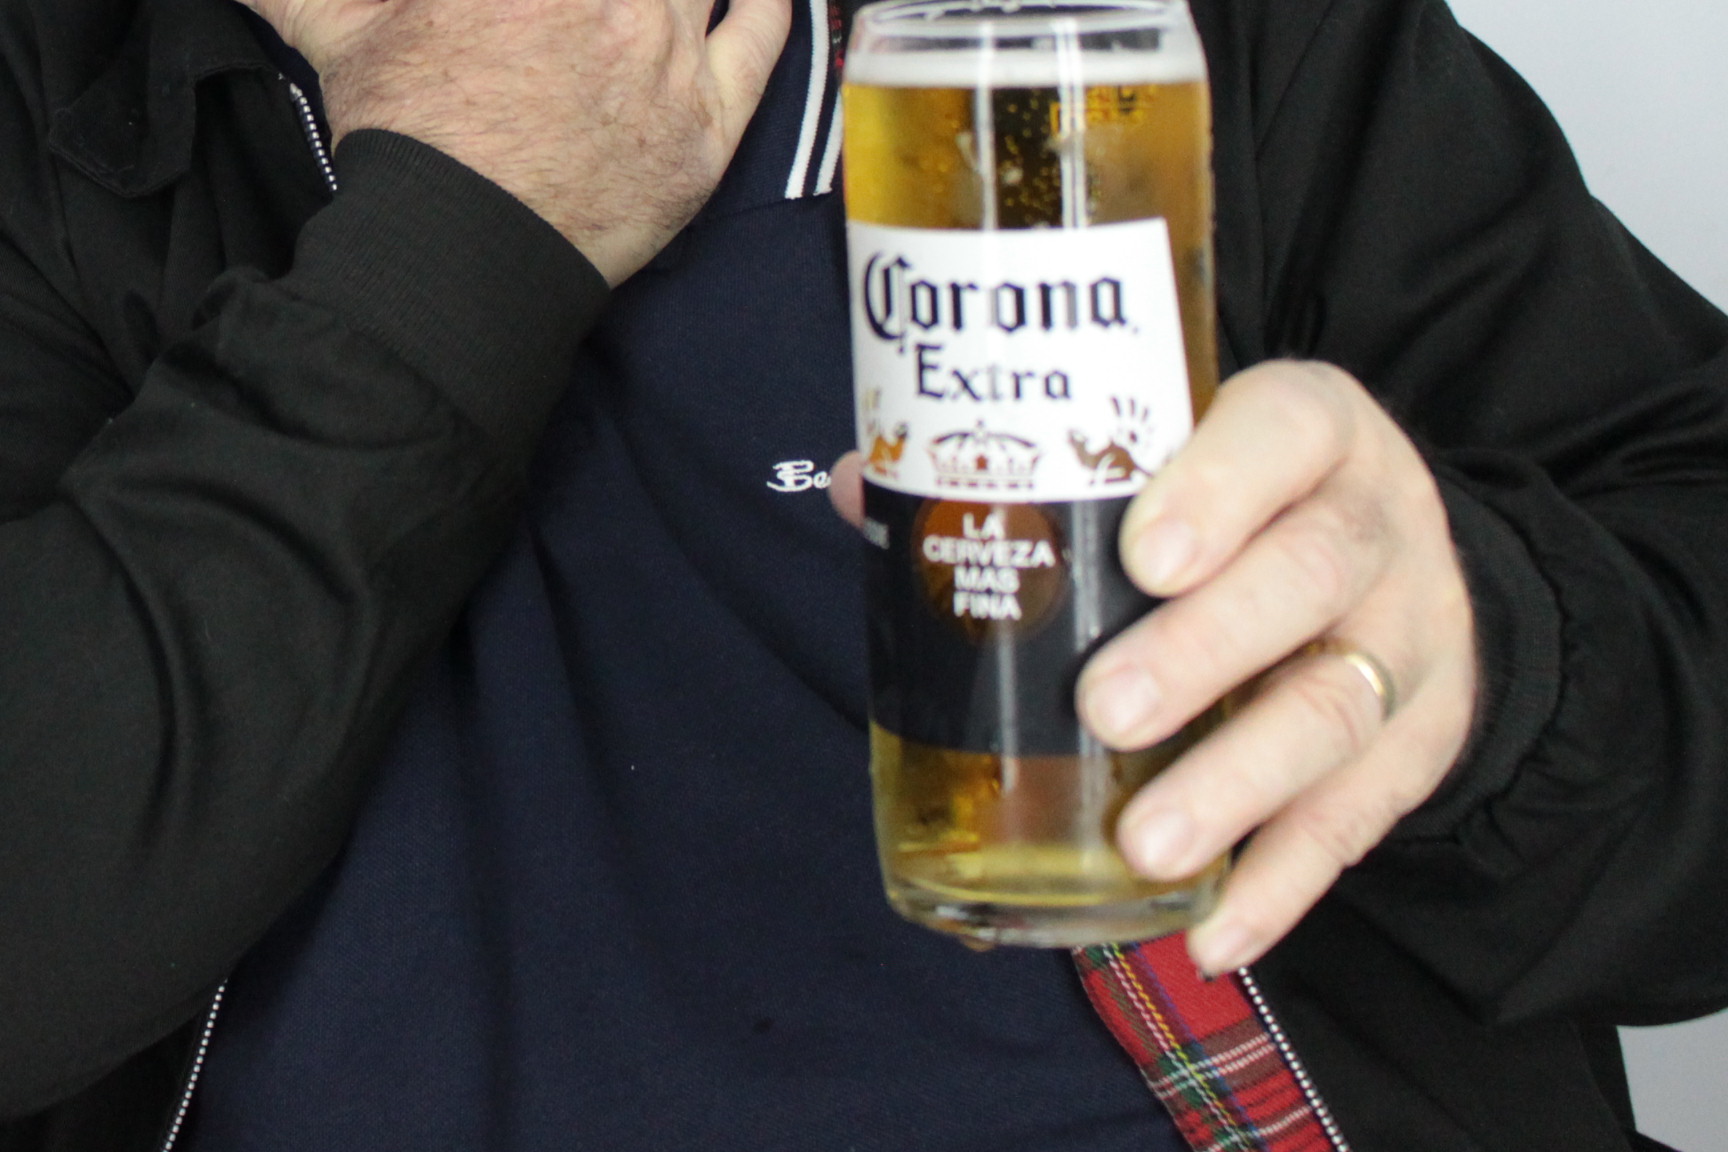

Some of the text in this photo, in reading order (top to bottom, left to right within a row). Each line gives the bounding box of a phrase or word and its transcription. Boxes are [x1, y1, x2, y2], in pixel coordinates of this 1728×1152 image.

[864, 252, 1130, 354] Corona
[915, 343, 1073, 402] Extra
[962, 512, 1007, 540] LA
[923, 534, 1056, 568] CERVEZA
